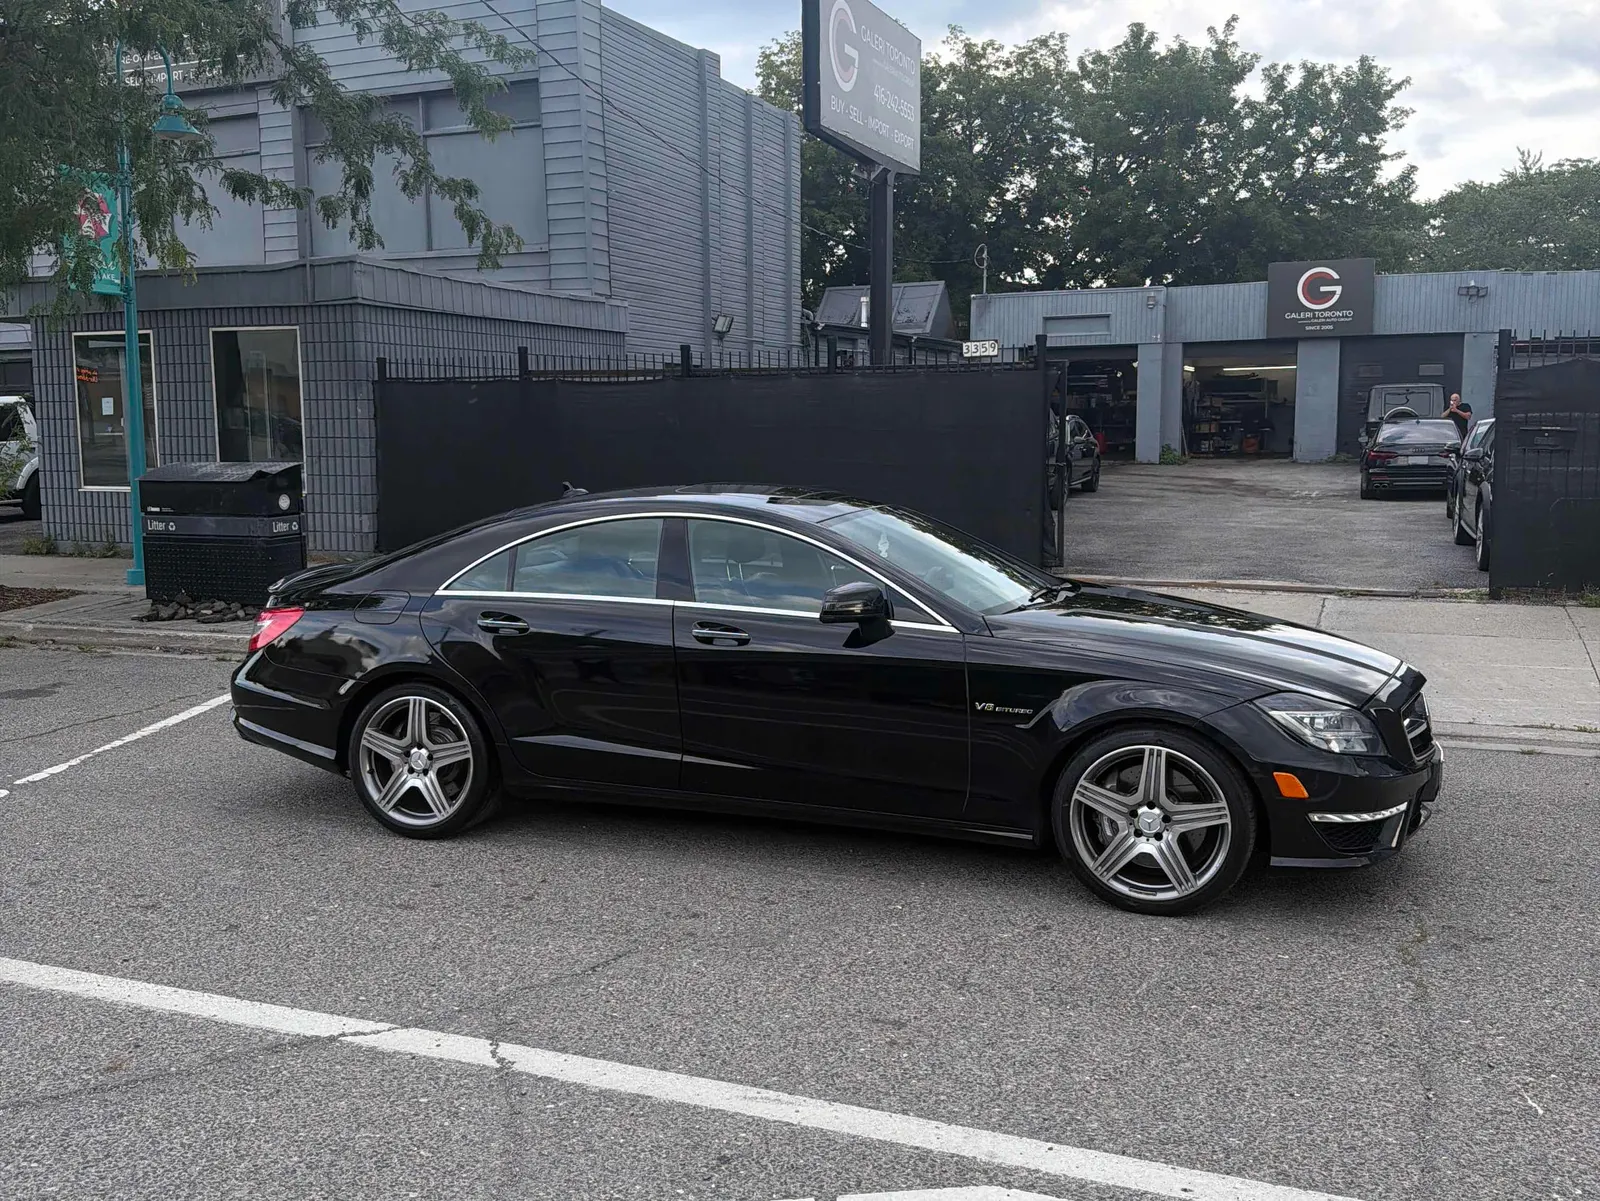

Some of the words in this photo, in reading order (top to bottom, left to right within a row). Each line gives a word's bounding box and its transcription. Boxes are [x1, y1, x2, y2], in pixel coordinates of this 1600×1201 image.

[829, 0, 859, 92] G
[860, 25, 885, 55] GALERI
[885, 41, 915, 75] TORONTO
[151, 69, 184, 84] IMPRT
[830, 95, 845, 115] BUY
[849, 105, 864, 126] SELL
[867, 115, 890, 139] IMPORT
[894, 129, 915, 151] EXPORT
[1297, 266, 1343, 310] G
[1285, 311, 1313, 319] GALERI
[1315, 310, 1354, 318] TORONTO
[964, 342, 996, 354] 3359
[147, 519, 166, 531] Litter
[272, 521, 290, 533] Litter
